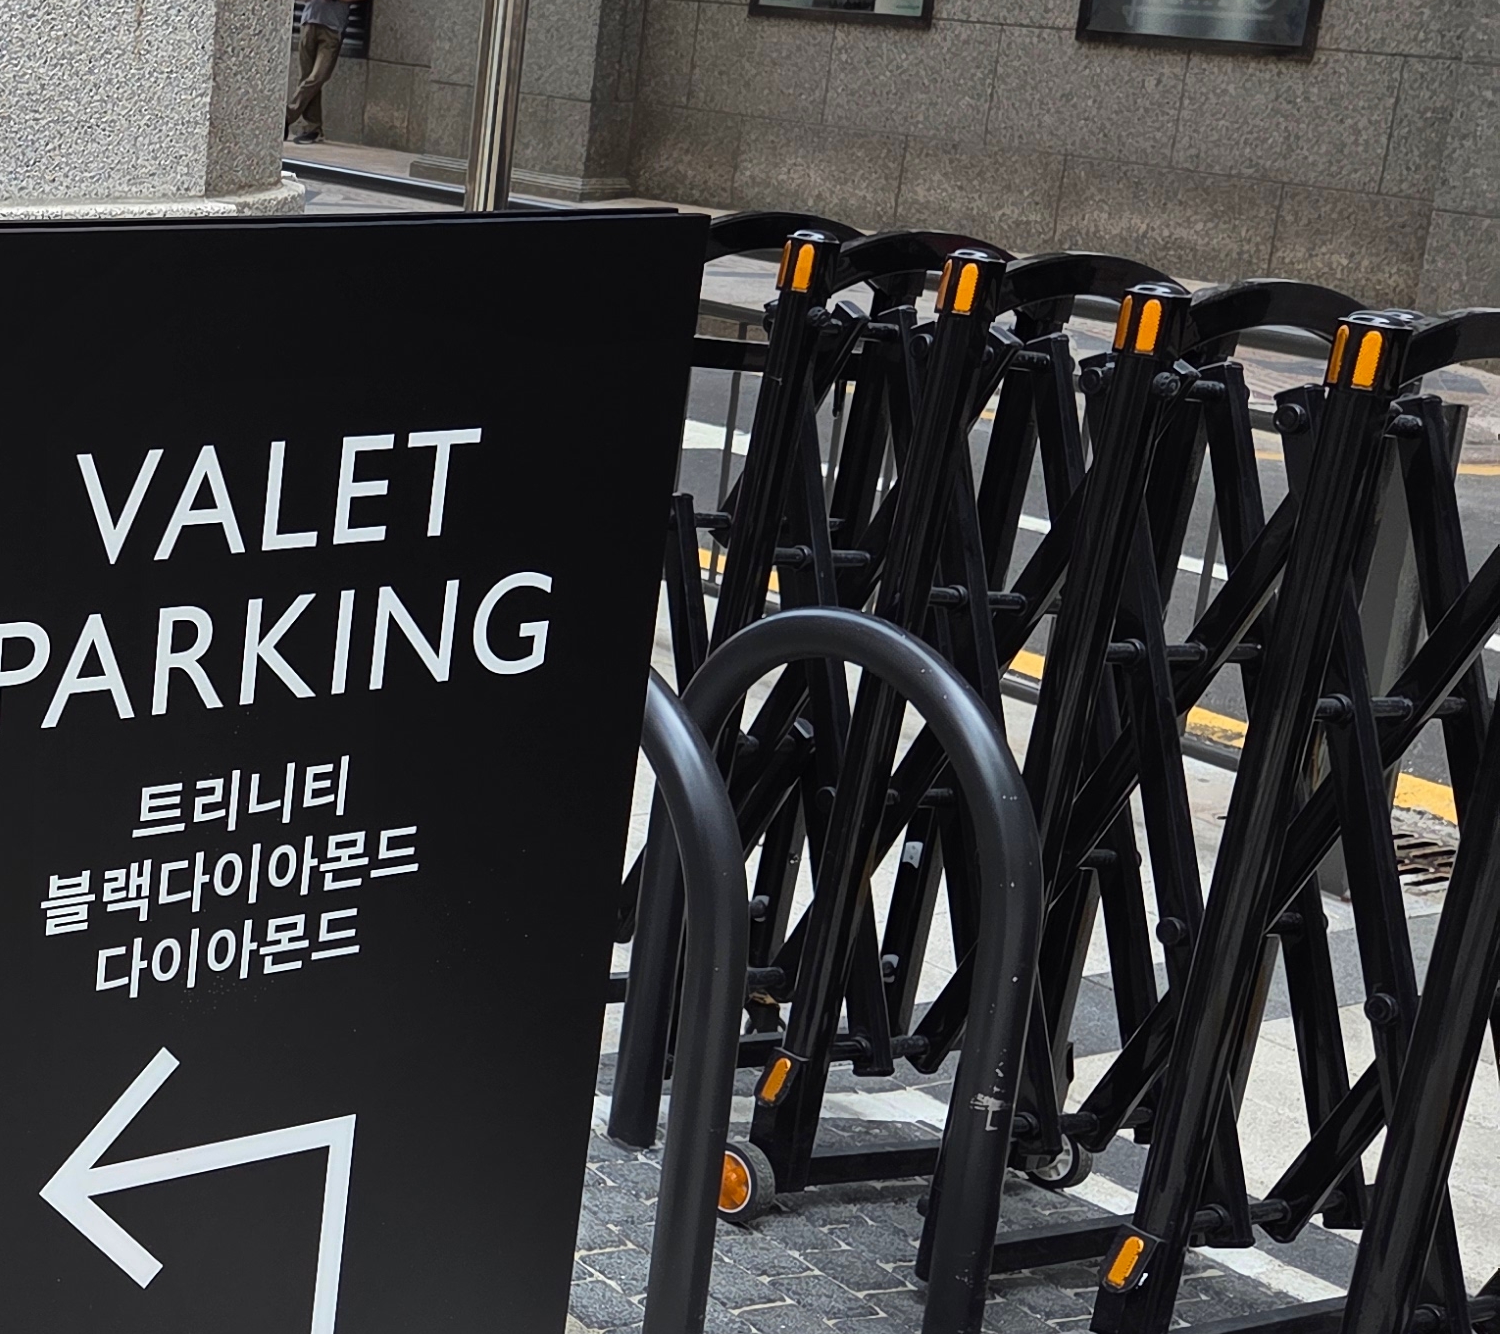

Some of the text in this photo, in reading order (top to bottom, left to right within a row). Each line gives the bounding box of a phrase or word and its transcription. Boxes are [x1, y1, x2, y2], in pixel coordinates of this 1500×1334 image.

[76, 427, 482, 565] VALET
[131, 754, 350, 839] 트리니티
[40, 825, 419, 937] 블랙다이아몬드
[95, 907, 361, 999] 다이아몬드
